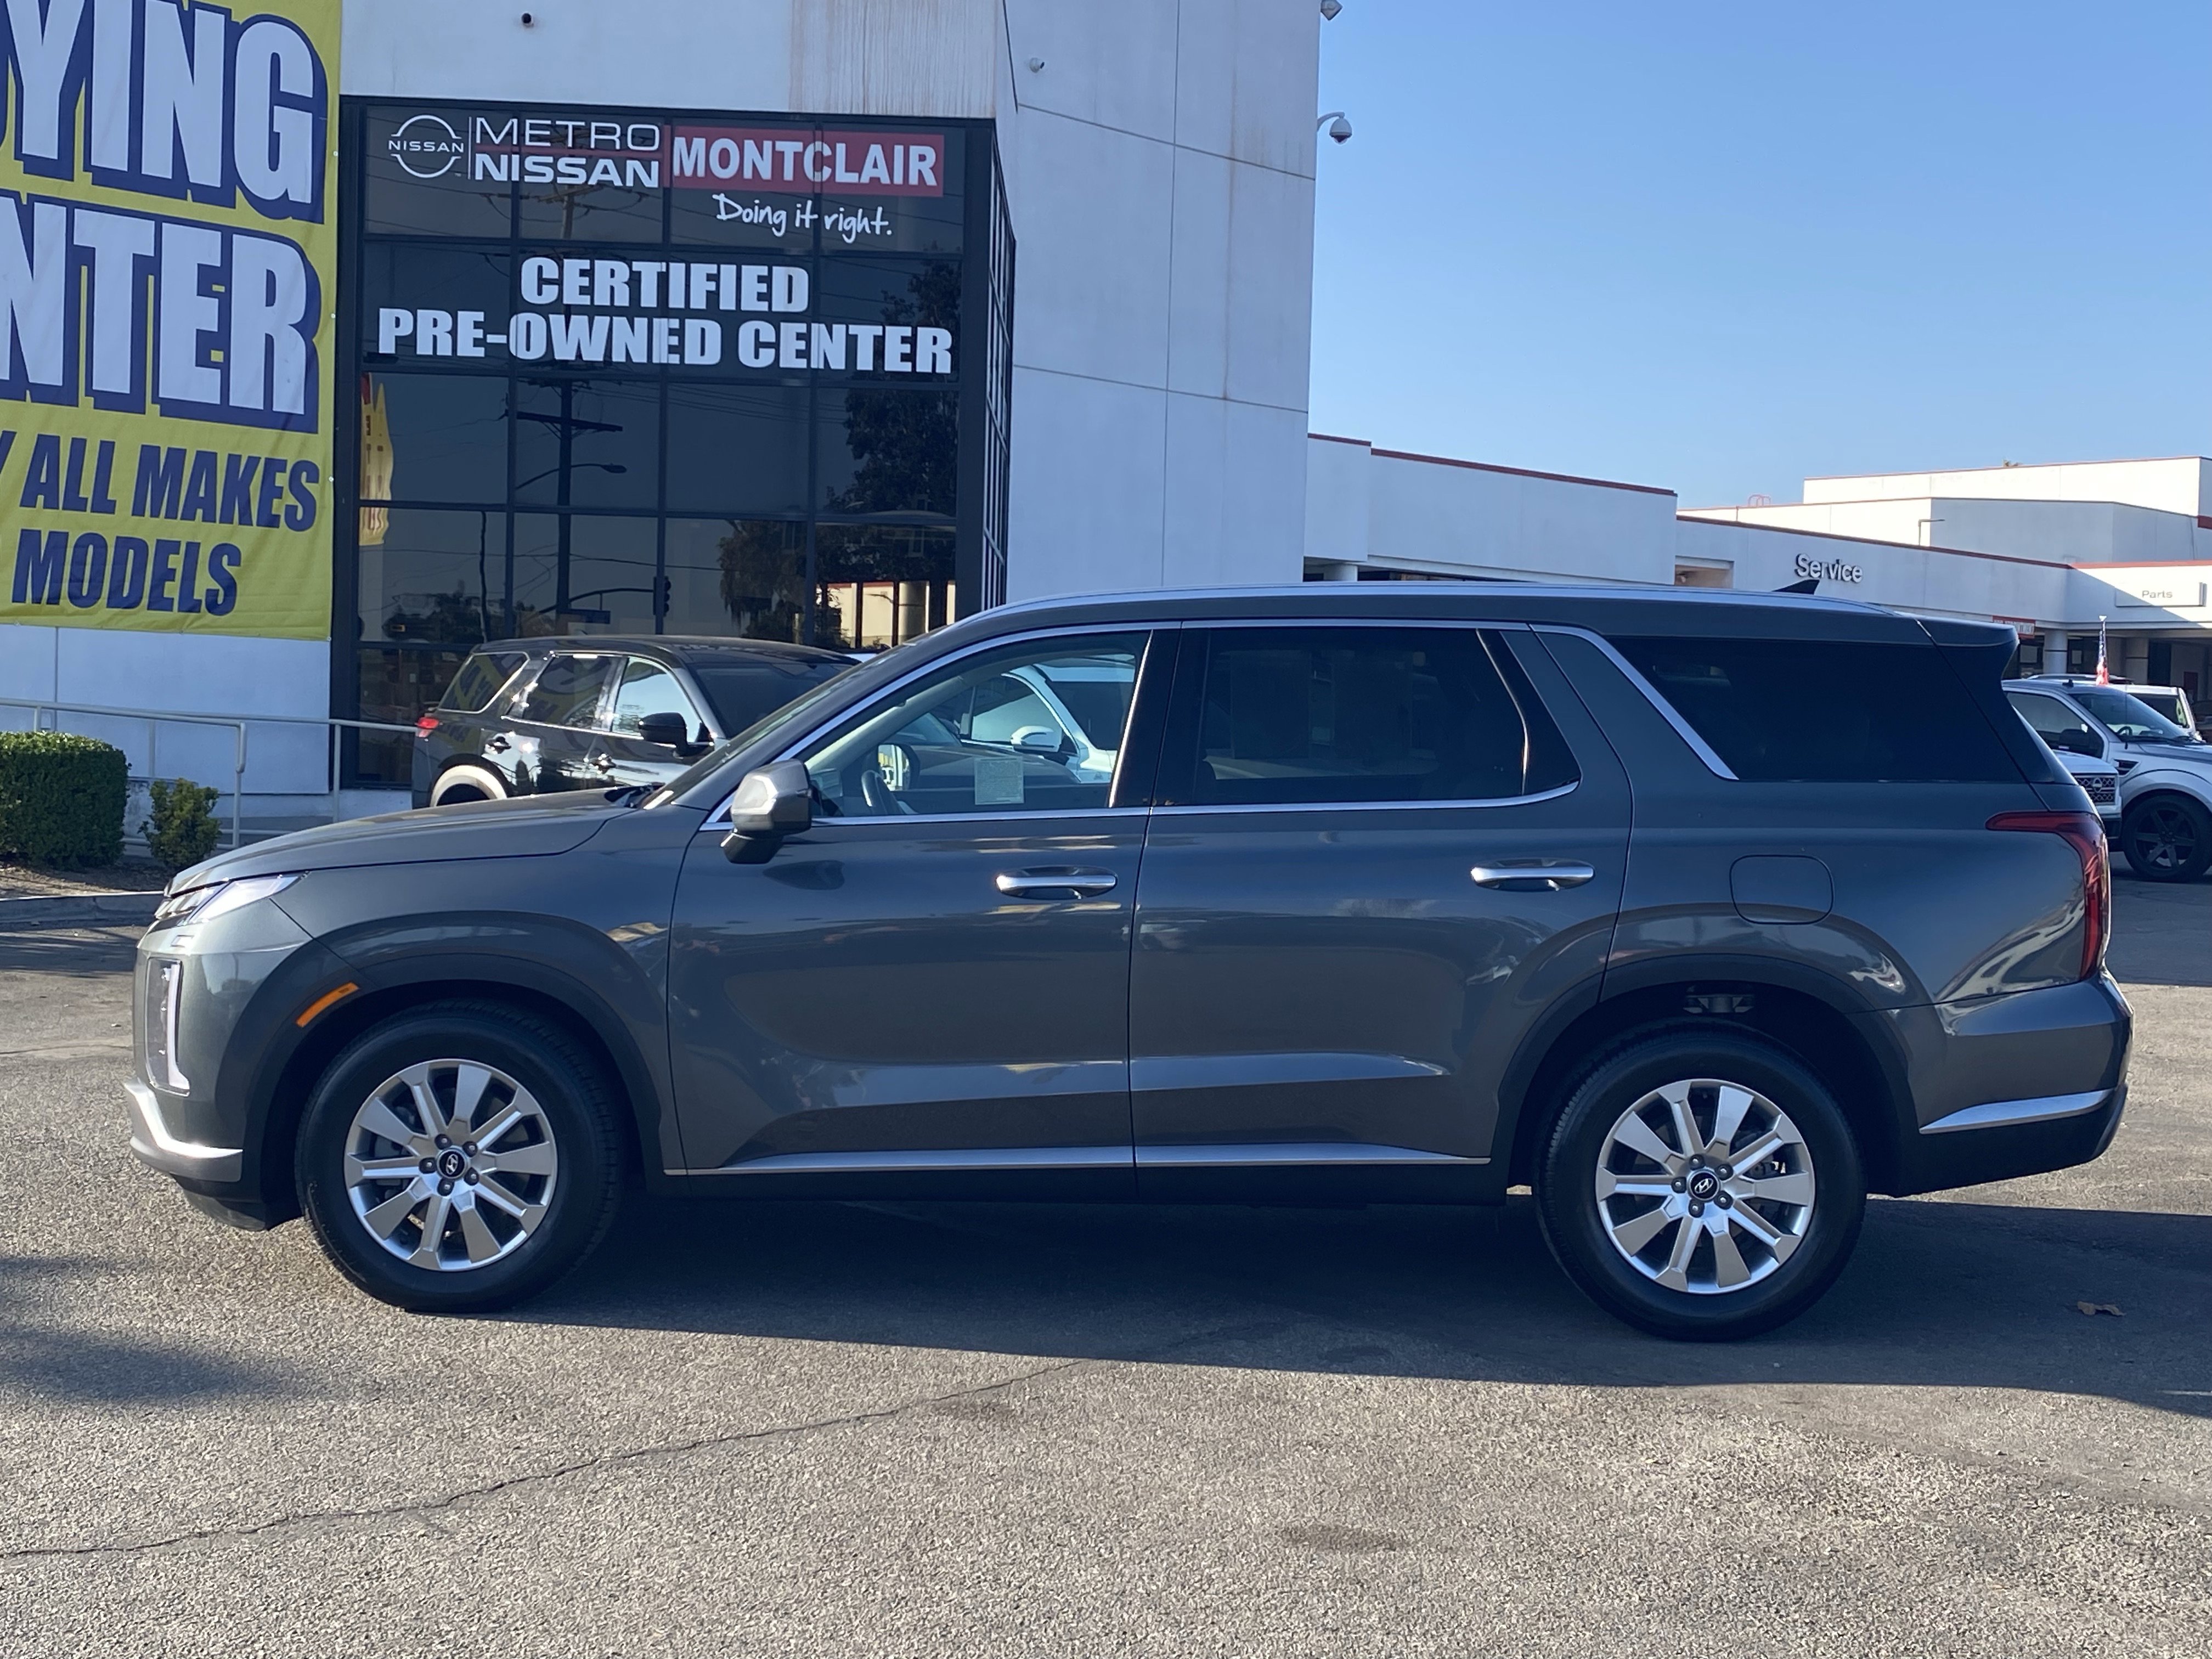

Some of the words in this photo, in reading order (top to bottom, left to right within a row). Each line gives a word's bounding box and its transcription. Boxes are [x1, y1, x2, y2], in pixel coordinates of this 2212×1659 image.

[388, 140, 464, 154] NISSAN
[476, 117, 659, 151] METRO
[475, 153, 659, 188] NISSAN
[673, 136, 938, 187] MONTCLAIR
[712, 193, 787, 237] Doing
[795, 200, 819, 228] it
[824, 206, 892, 244] right.
[520, 256, 809, 313] CERTIFIED
[378, 307, 723, 365] PRE-OWNED
[738, 320, 953, 374] CENTER
[19, 433, 116, 515] ALL
[131, 444, 320, 532] MAKES
[11, 528, 242, 617] MODELS
[1794, 553, 1864, 583] Service
[2141, 590, 2173, 599] Parts
